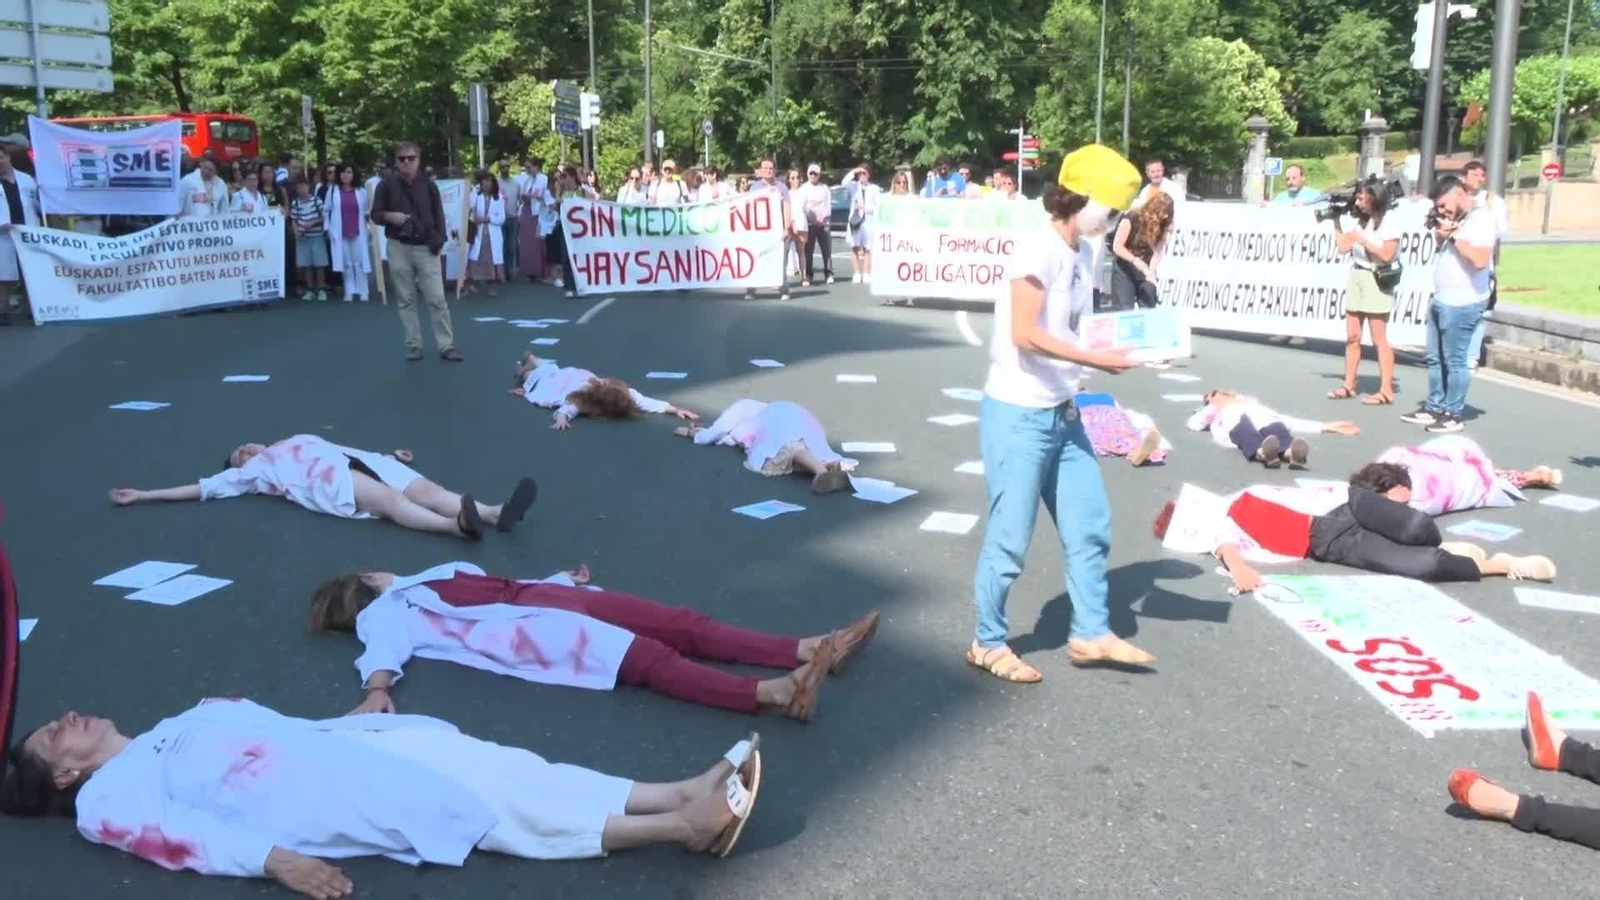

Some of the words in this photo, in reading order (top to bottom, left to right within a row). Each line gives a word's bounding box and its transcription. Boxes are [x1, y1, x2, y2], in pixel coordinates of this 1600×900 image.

[113, 148, 172, 172] SME
[566, 203, 615, 238] SIN
[620, 204, 720, 237] MEDICO
[730, 197, 771, 232] NO
[20, 232, 93, 251] EUSKADI,
[97, 242, 127, 250] POR
[159, 220, 219, 237] ESTATUTO
[269, 215, 276, 226] Y
[879, 233, 891, 252] 11
[90, 239, 185, 262] FACULTATIVO
[188, 235, 234, 249] PROPIO
[127, 256, 191, 276] ESTATUTU
[193, 251, 241, 266] MEDIKO
[243, 247, 265, 260] ETA
[77, 275, 177, 295] FAKULTATIBO
[180, 269, 215, 285] BATEN
[218, 265, 249, 279] ALDE
[573, 251, 630, 286] HAY
[635, 246, 755, 284] SANIDAD
[257, 278, 280, 291] SME
